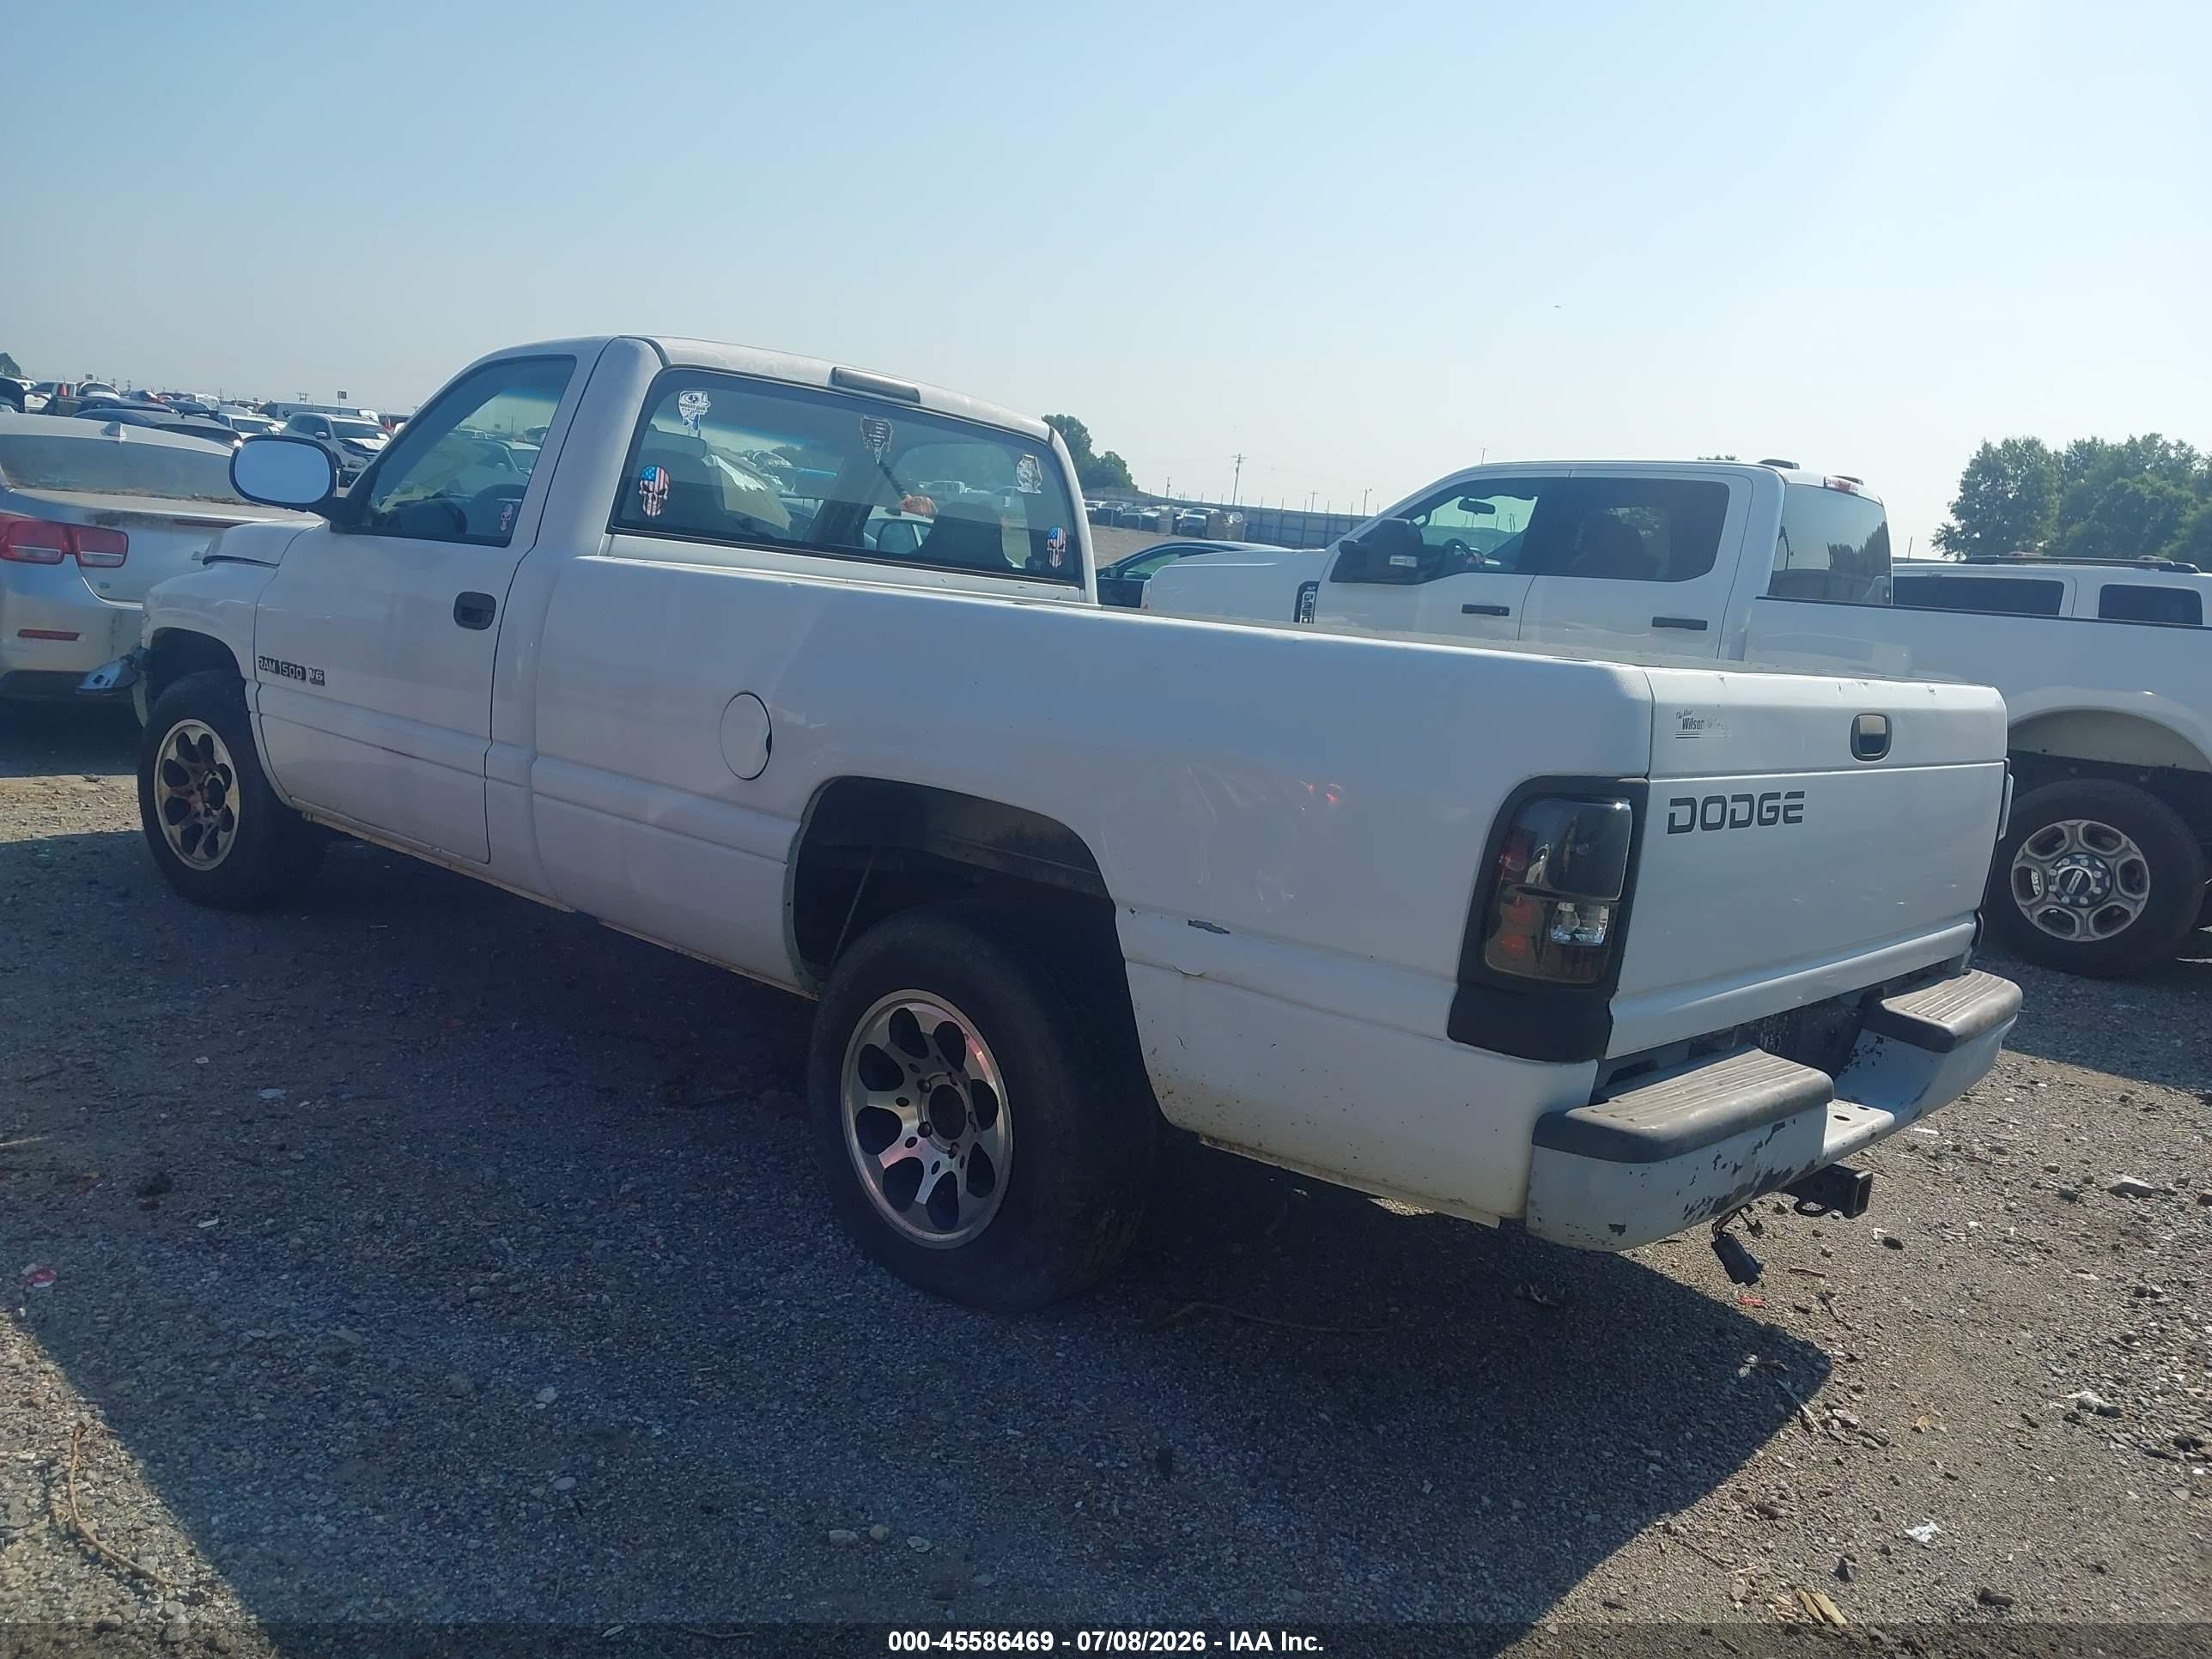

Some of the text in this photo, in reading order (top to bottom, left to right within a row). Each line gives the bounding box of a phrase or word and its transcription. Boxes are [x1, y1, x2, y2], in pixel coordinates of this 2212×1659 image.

[258, 657, 324, 681] RAM 1500 V6
[1667, 791, 1805, 834] DODGE
